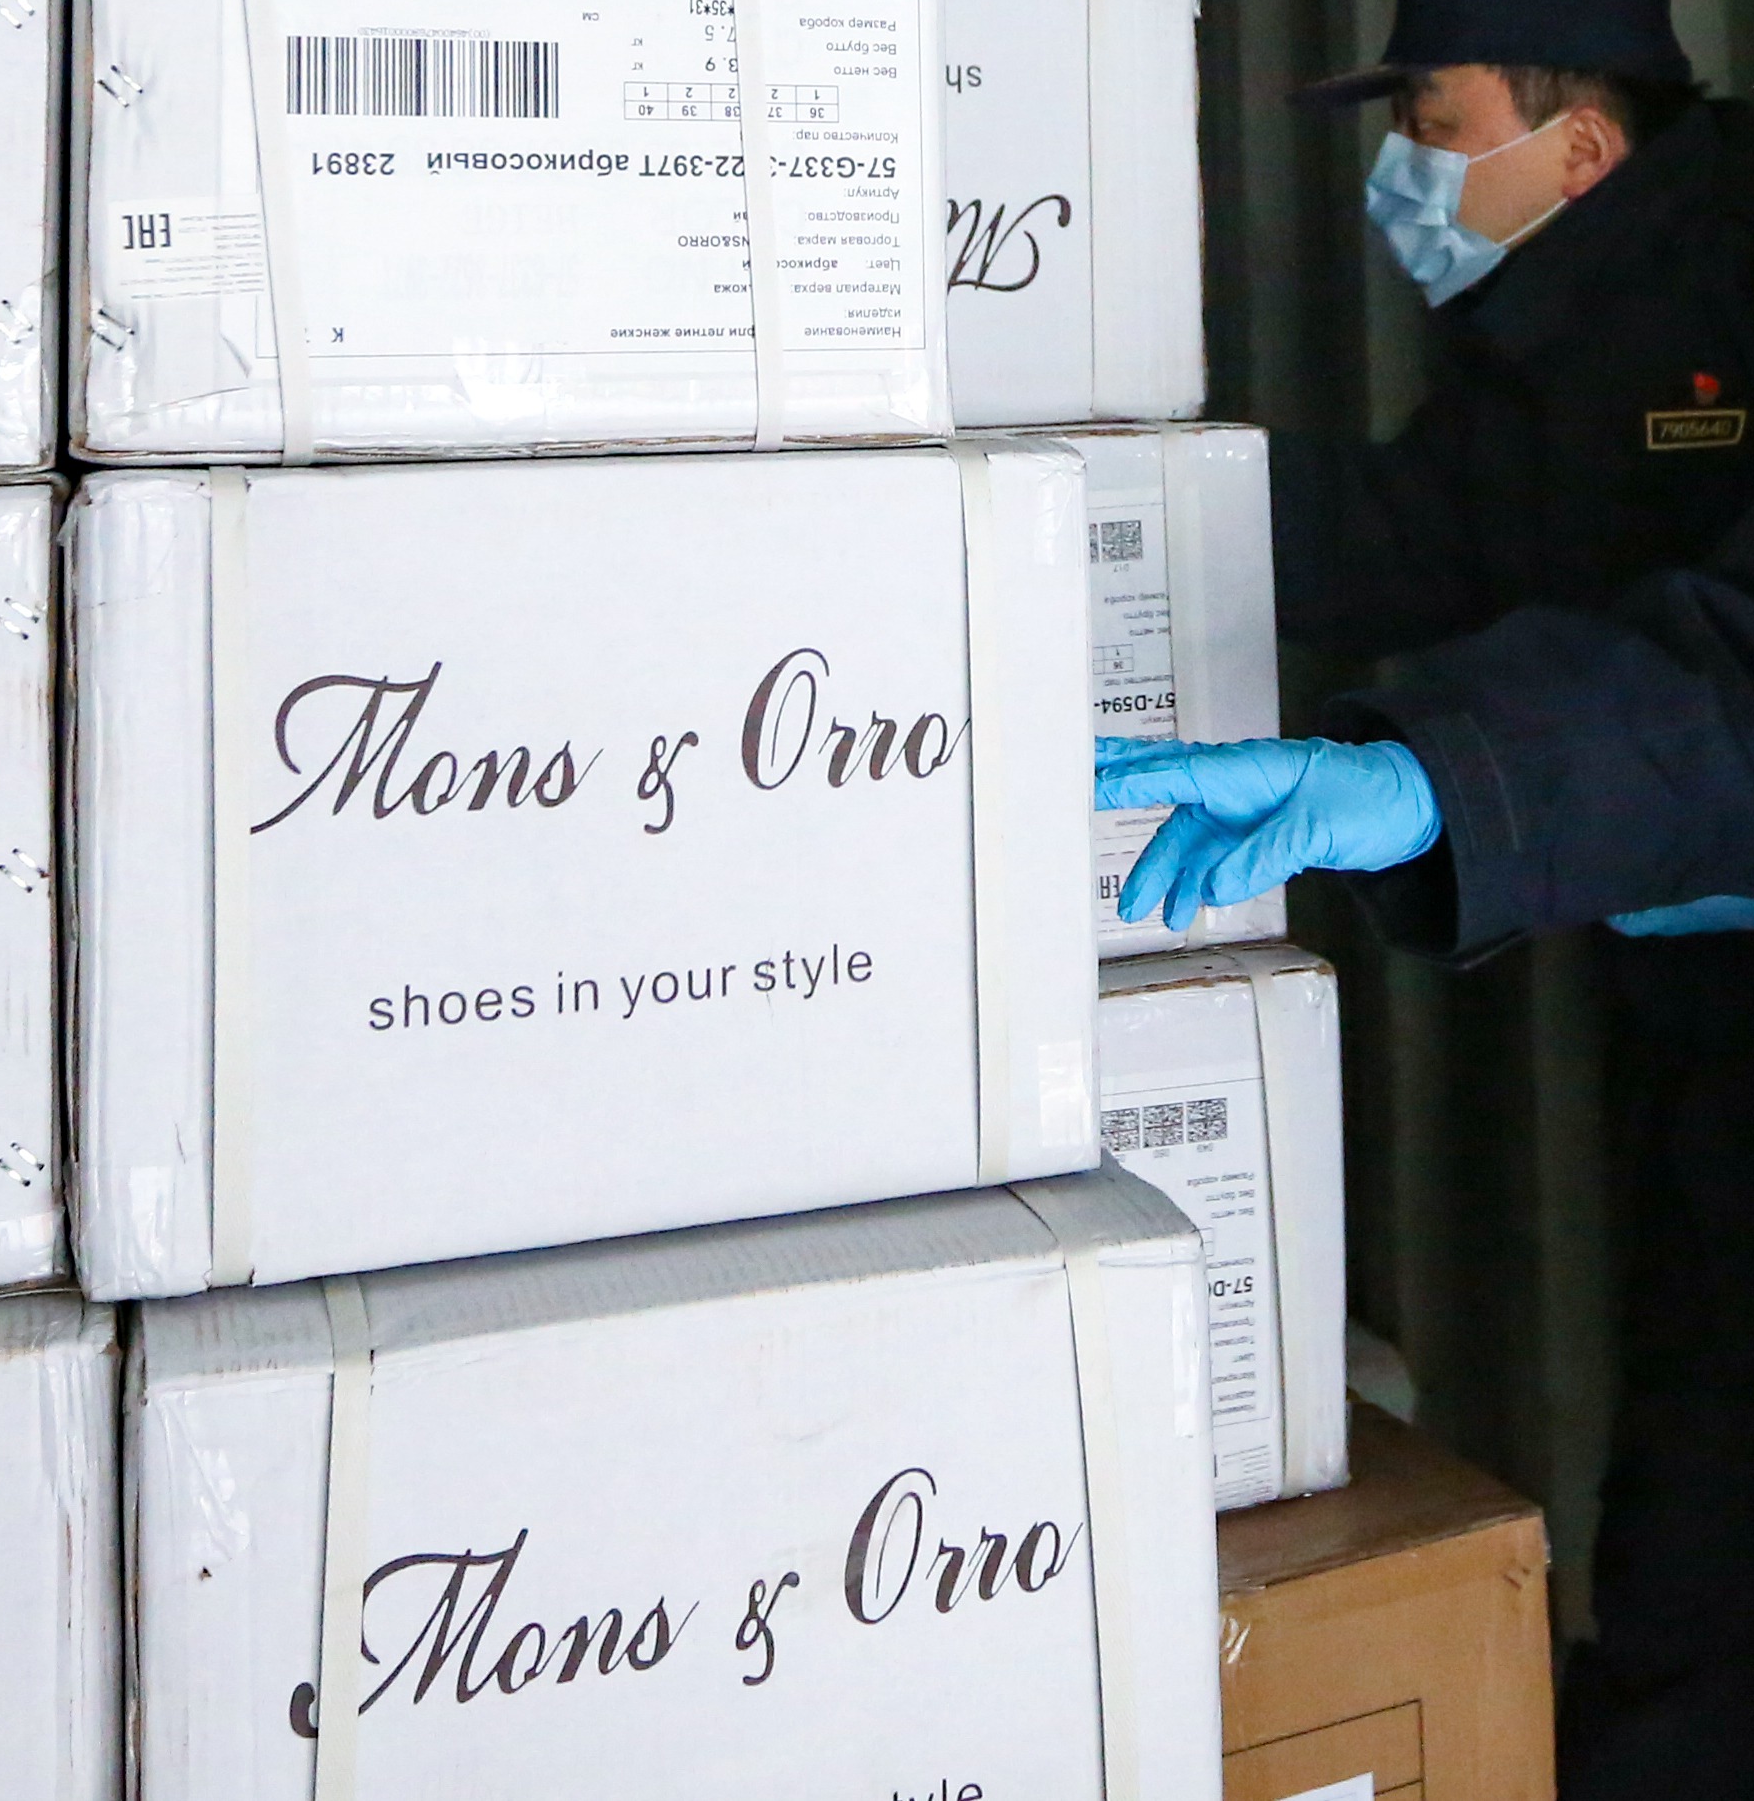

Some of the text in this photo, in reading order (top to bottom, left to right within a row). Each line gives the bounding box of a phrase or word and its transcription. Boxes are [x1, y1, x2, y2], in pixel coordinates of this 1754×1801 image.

[822, 130, 899, 145] Количество
[312, 152, 396, 176] 23891
[427, 148, 630, 177] абрикосовый
[803, 209, 900, 225] Производство:
[792, 233, 901, 249] Торговая марка:
[791, 280, 902, 296] Материал верха:
[609, 325, 902, 339] Наименование летние женские
[250, 659, 603, 836] Mons
[740, 646, 971, 791] Orro
[367, 942, 875, 1033] shoes in your style
[290, 1528, 699, 1738] Mons
[843, 1467, 1084, 1626] Orro
